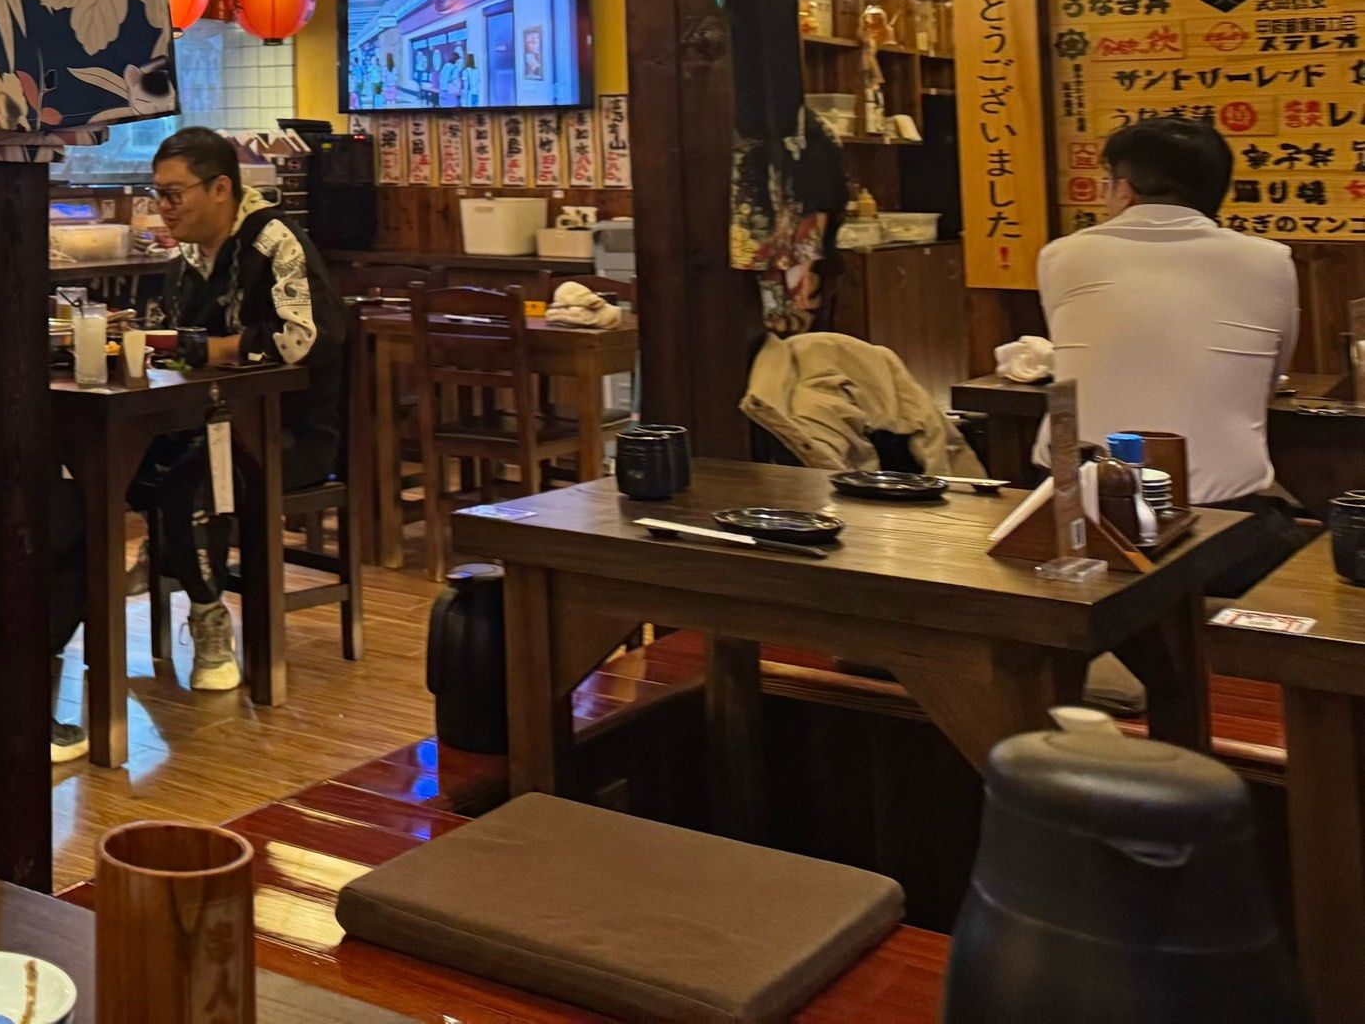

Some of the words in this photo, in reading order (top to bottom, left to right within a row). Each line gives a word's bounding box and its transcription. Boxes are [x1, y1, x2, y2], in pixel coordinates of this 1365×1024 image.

[1113, 66, 1326, 91] サントリーレッド
